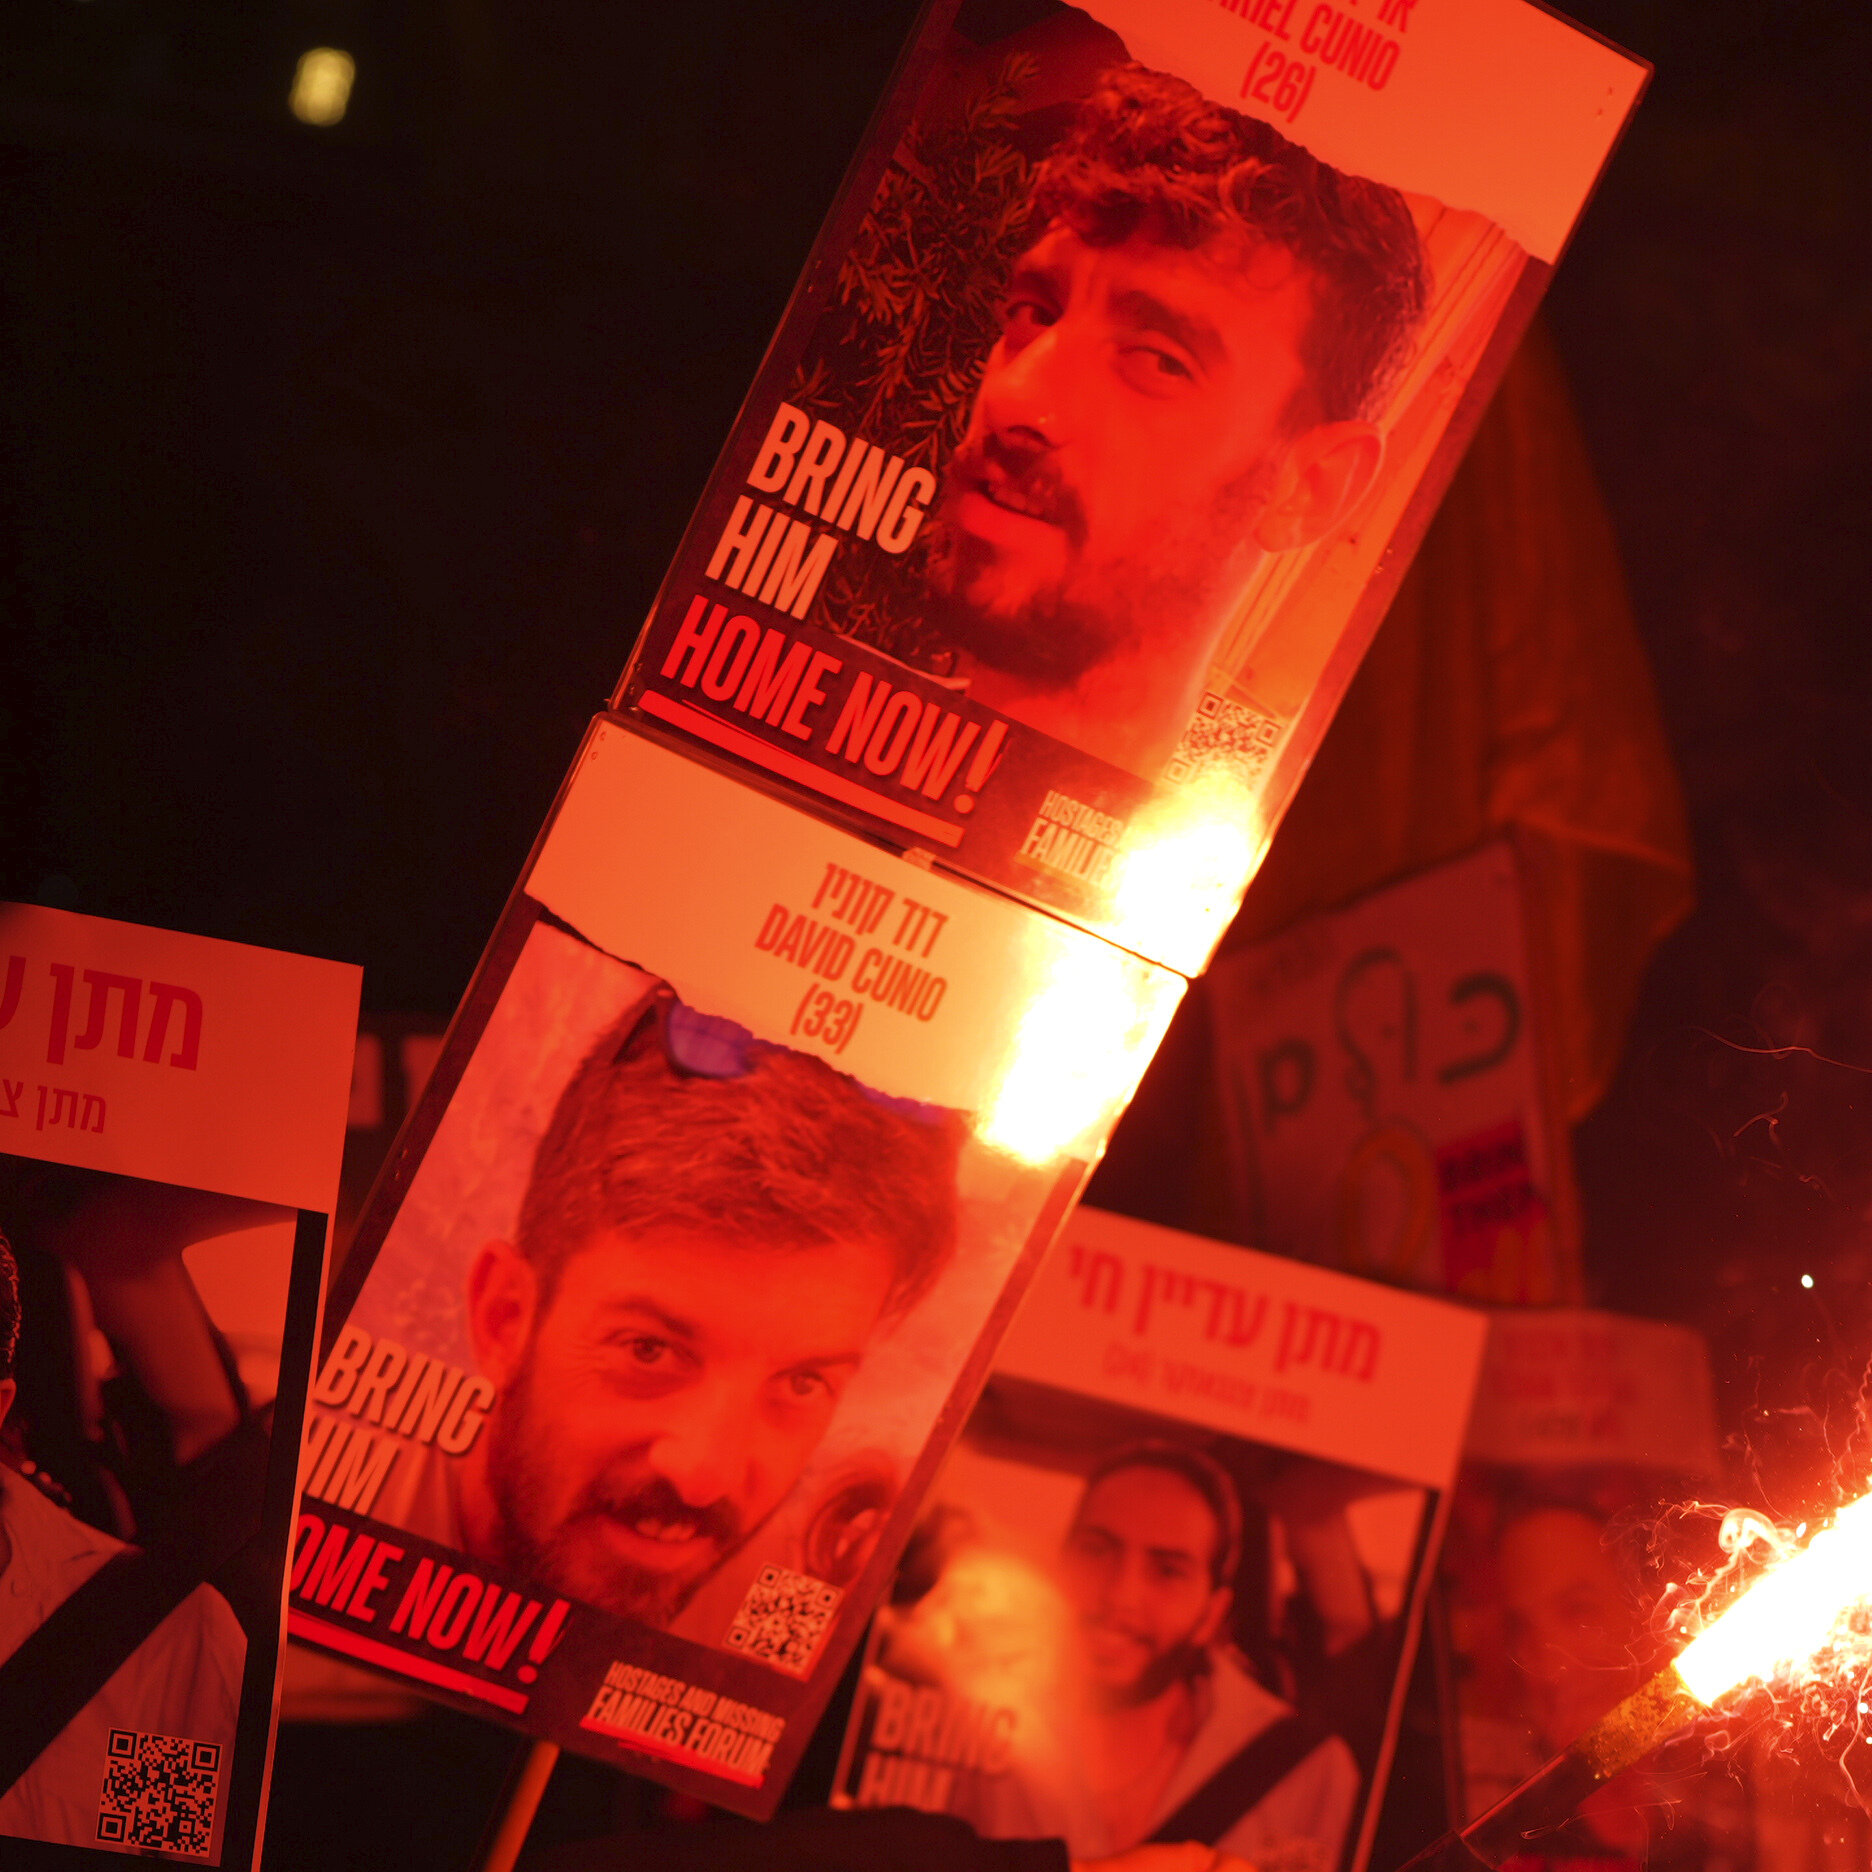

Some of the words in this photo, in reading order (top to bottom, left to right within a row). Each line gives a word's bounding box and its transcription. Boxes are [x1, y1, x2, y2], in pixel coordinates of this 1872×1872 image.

[1239, 41, 1317, 124] (26)
[1300, 4, 1401, 91] CUNIO
[745, 402, 937, 556] BRING
[704, 493, 839, 621] HIM
[658, 592, 843, 741] HOME
[825, 670, 1010, 815] NOW!
[1039, 789, 1125, 849] HOSTAGES
[754, 902, 856, 982] DAVID
[850, 947, 948, 1023] CUNIO
[892, 897, 950, 959] דוד
[46, 961, 206, 1071] מתן
[789, 981, 865, 1055] (33)
[35, 1087, 108, 1135] מתן
[1068, 1244, 1124, 1315] חי
[1133, 1262, 1269, 1348] עדיין
[1274, 1301, 1382, 1384] מתן
[315, 1325, 496, 1457] BRING
[291, 1513, 404, 1623] OME
[390, 1557, 573, 1685] NOW!
[587, 1685, 694, 1746] FAMILIES
[684, 1717, 775, 1776] FORUM
[604, 1660, 687, 1706] HOSTAGES
[678, 1685, 719, 1717] AND
[710, 1696, 786, 1743] MISSING
